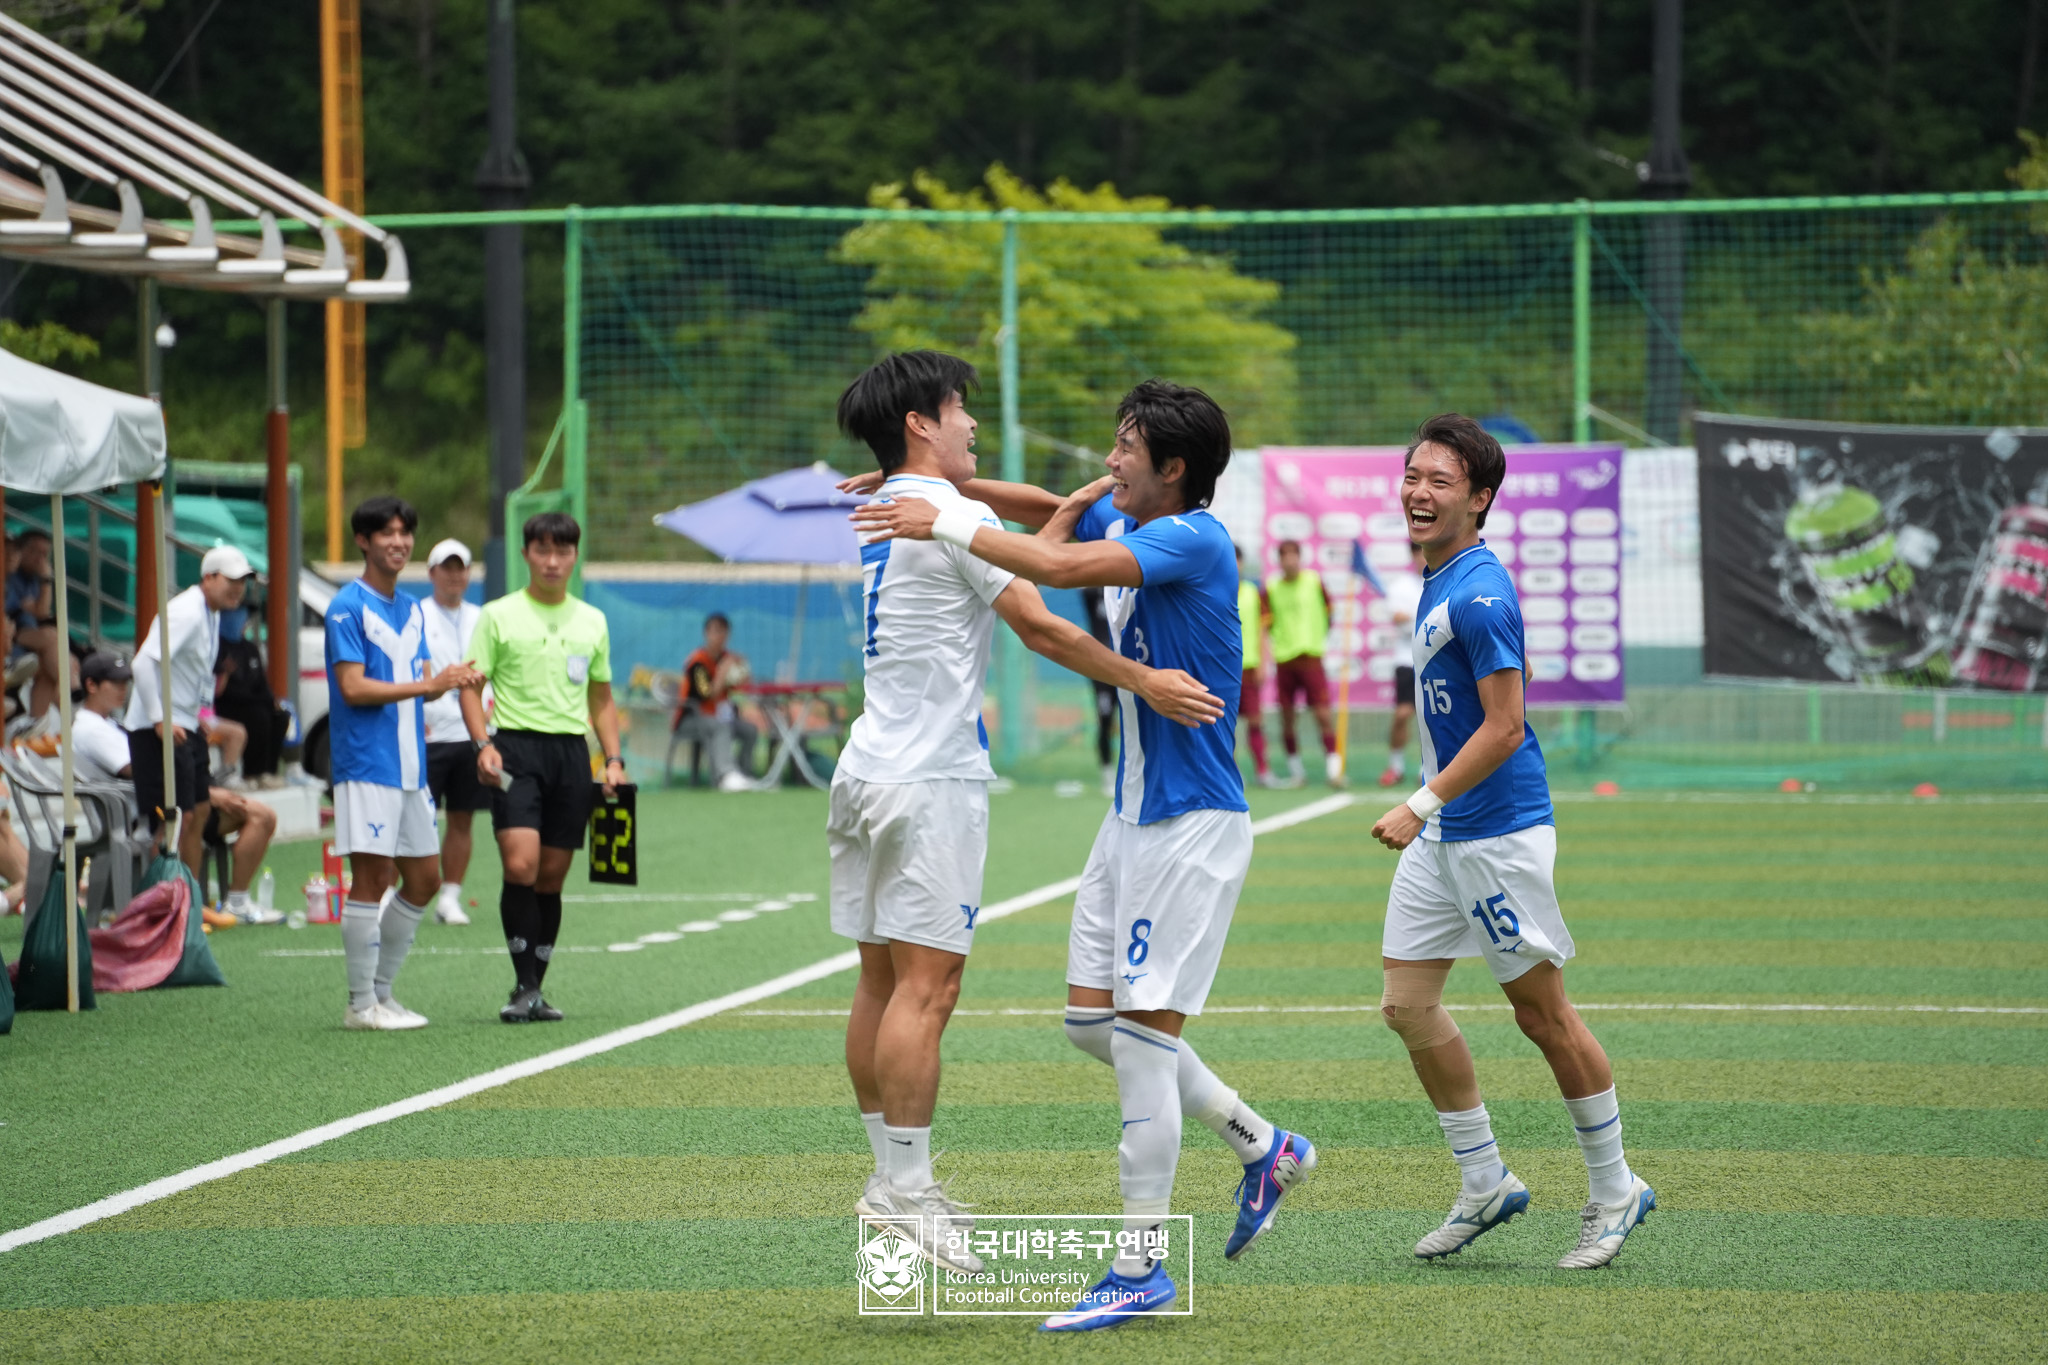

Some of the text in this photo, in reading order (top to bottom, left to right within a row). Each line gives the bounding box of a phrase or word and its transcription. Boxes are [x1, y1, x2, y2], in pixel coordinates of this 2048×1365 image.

[1424, 679, 1452, 715] 15
[1472, 892, 1520, 944] 15
[1127, 919, 1152, 966] 8
